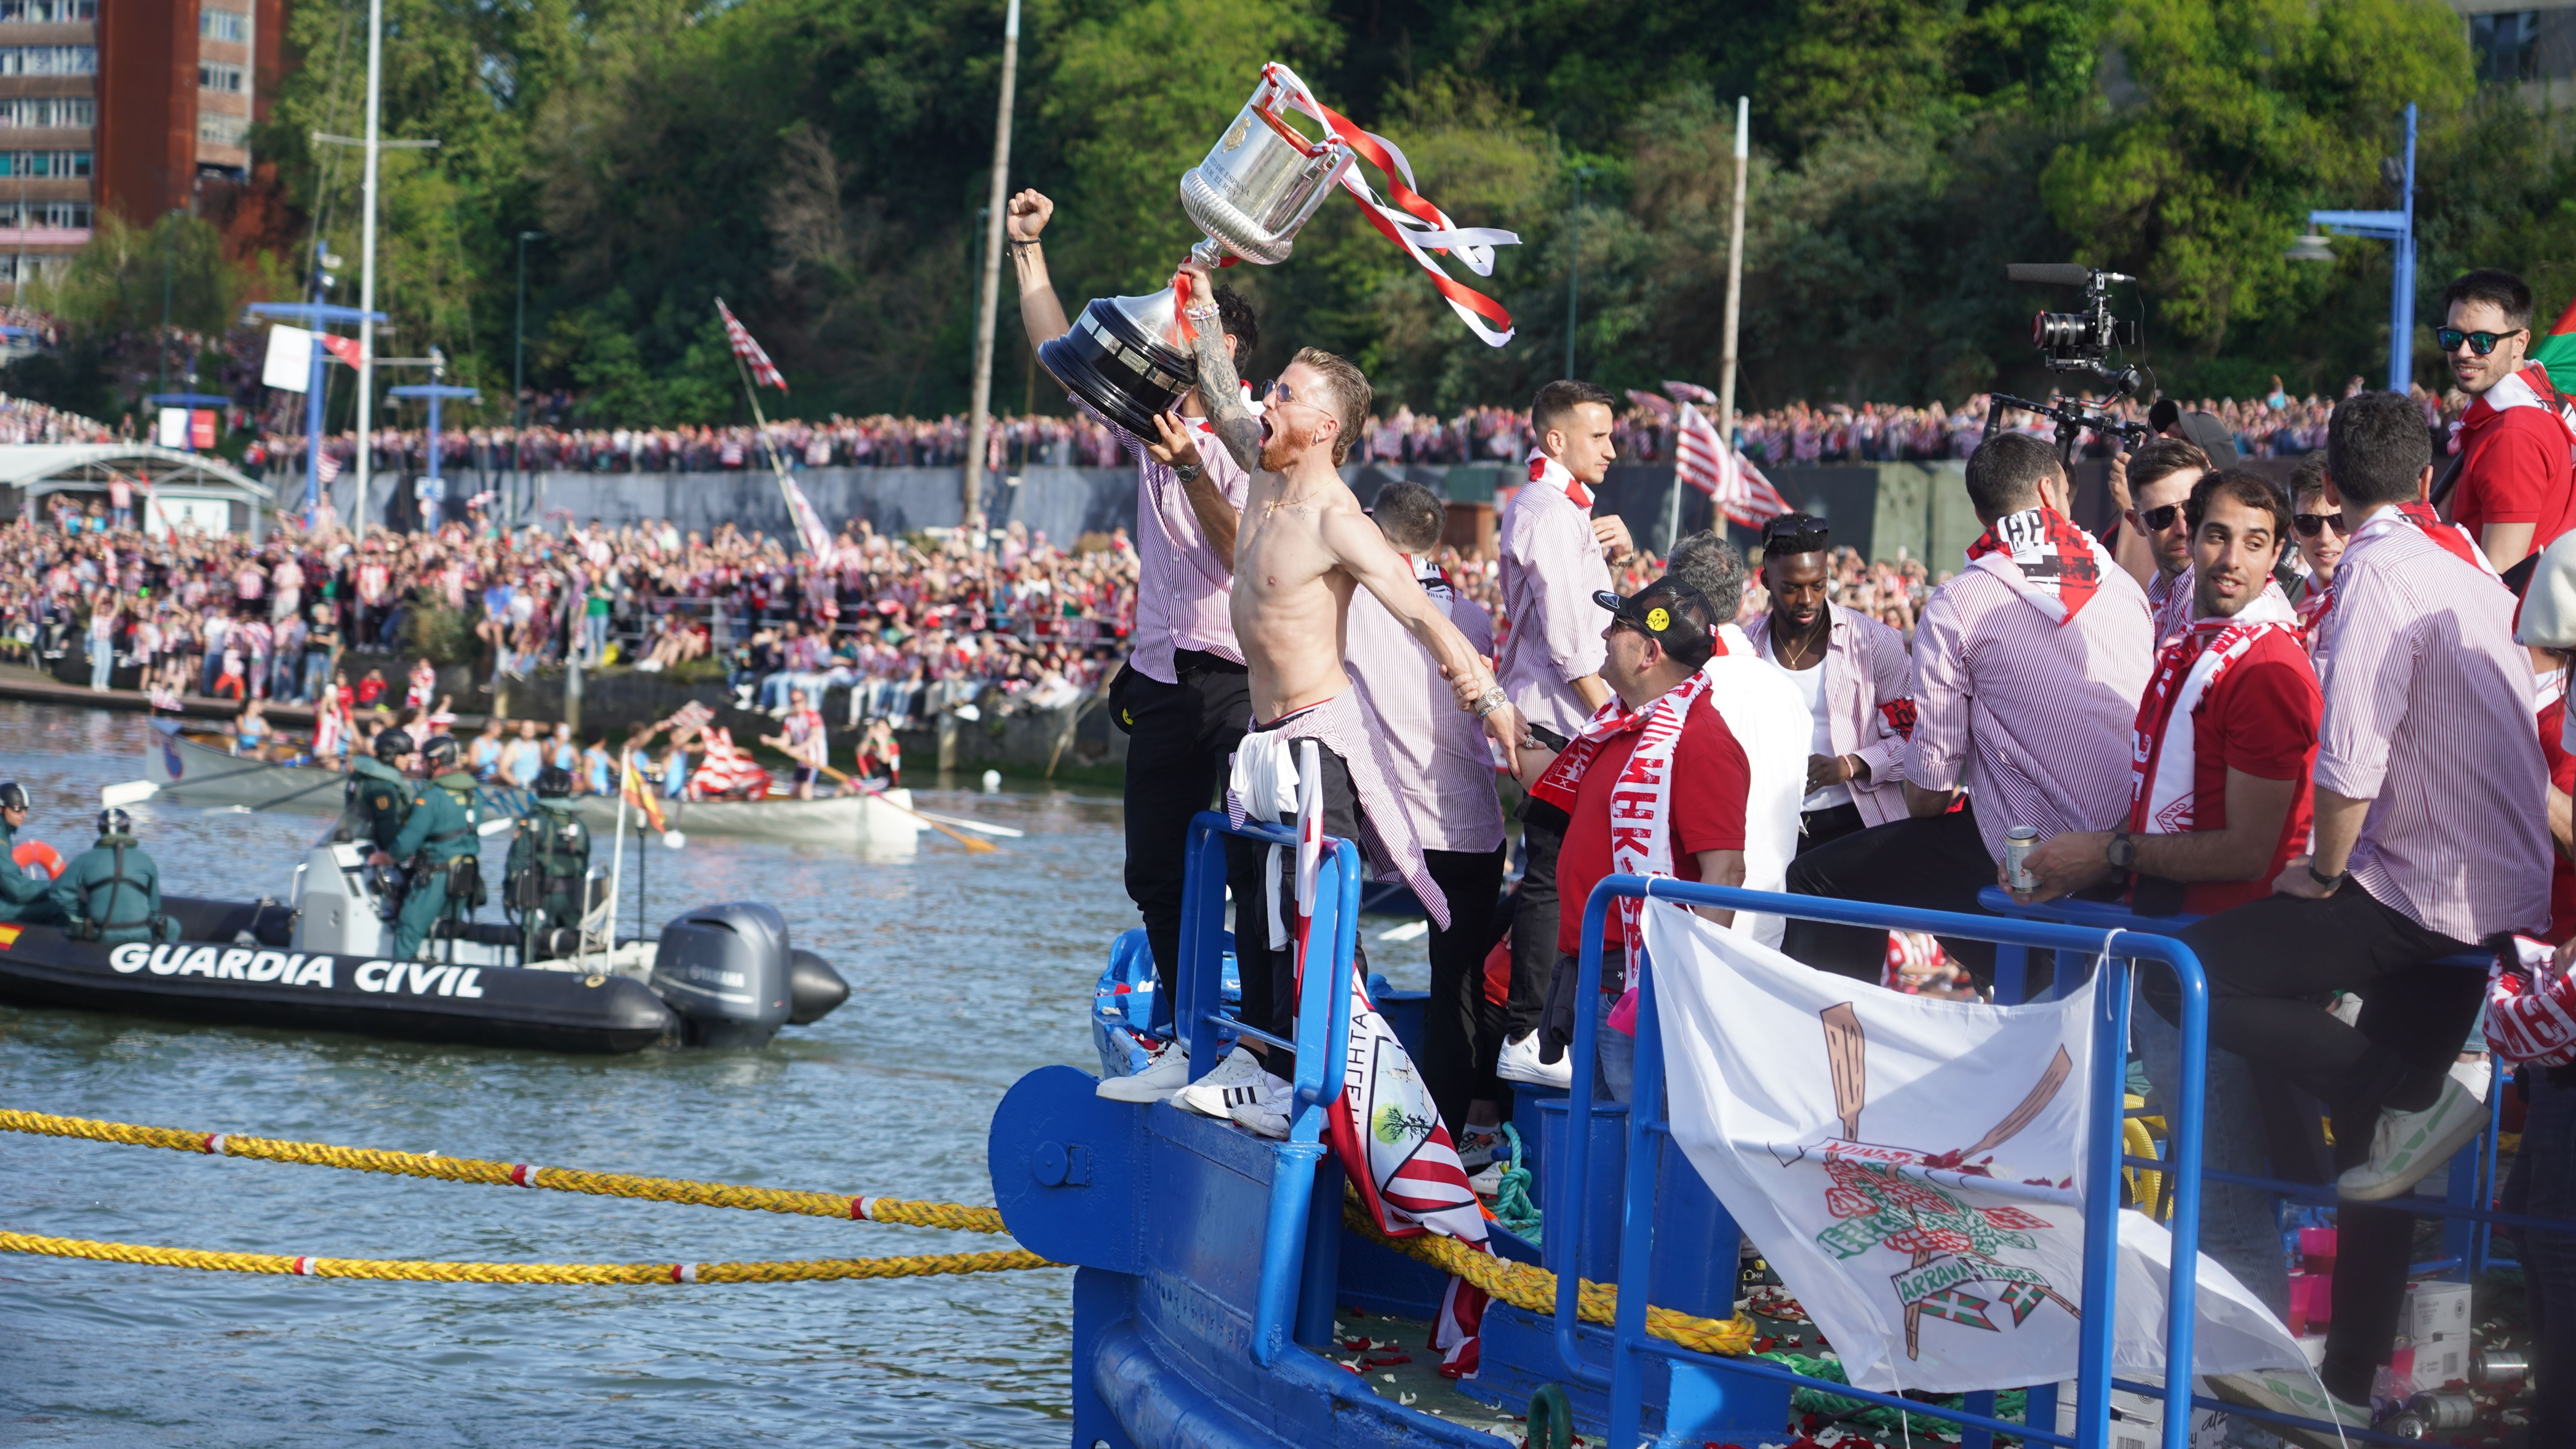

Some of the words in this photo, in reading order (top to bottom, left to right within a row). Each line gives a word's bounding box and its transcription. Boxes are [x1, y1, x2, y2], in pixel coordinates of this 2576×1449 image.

[1216, 163, 1225, 174] DE
[1224, 171, 1249, 196] ESPAÑA
[1222, 181, 1237, 197] REY
[109, 942, 334, 988] GUARDIA
[354, 960, 484, 999] CIVIL
